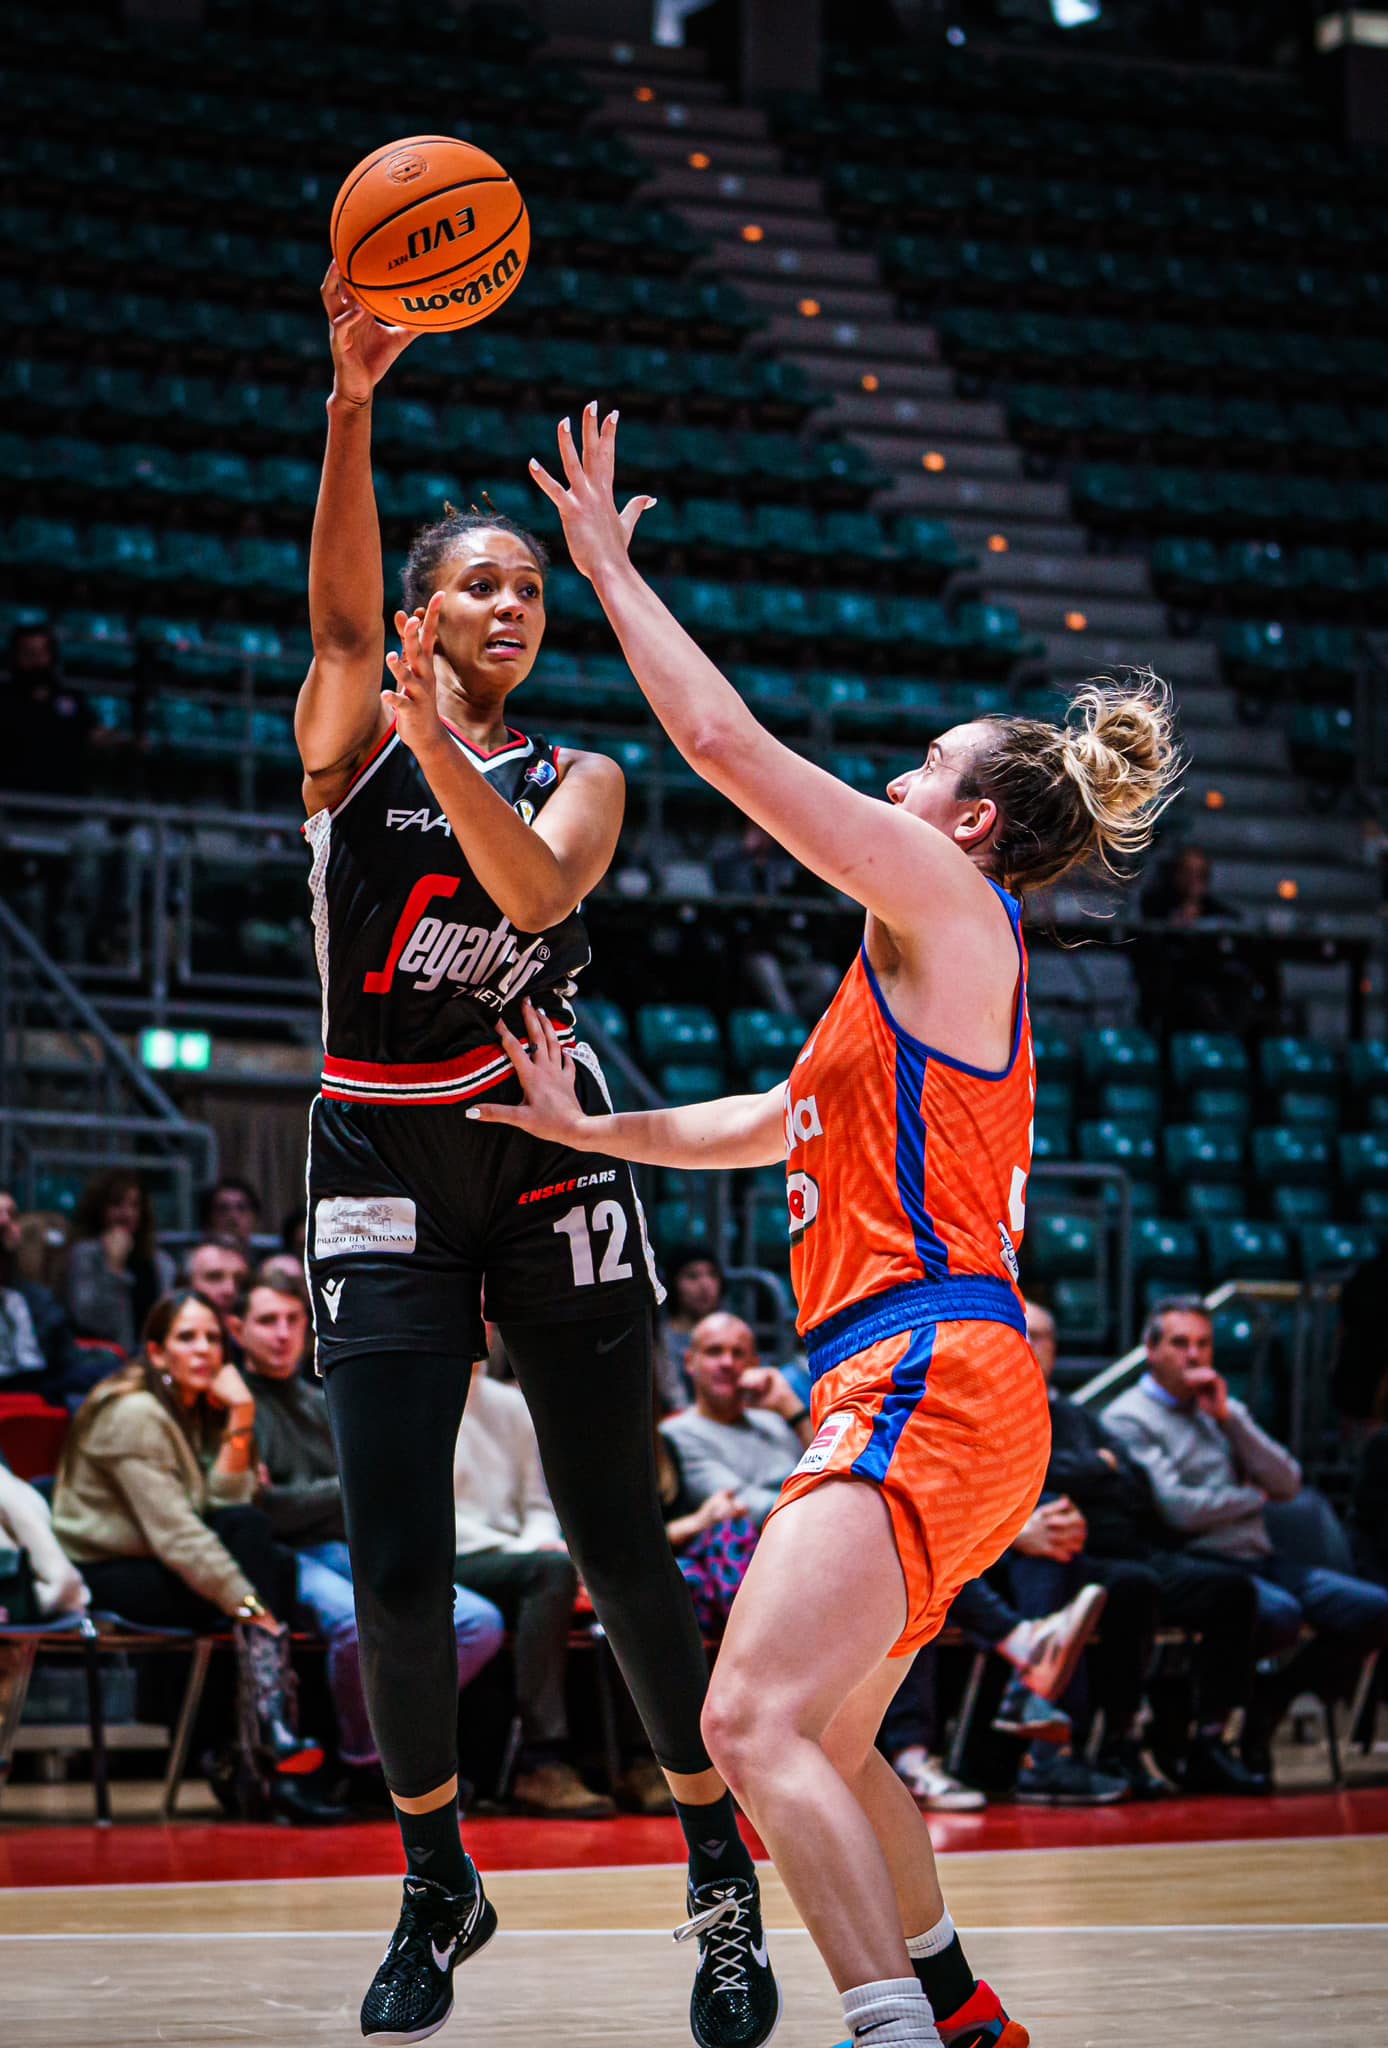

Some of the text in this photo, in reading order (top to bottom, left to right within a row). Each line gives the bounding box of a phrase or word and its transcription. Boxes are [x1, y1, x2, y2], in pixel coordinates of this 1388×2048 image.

[407, 206, 476, 260] EVO
[400, 248, 521, 314] Wilson
[359, 1233, 415, 1243] VARIGNANA
[552, 1199, 633, 1287] 12
